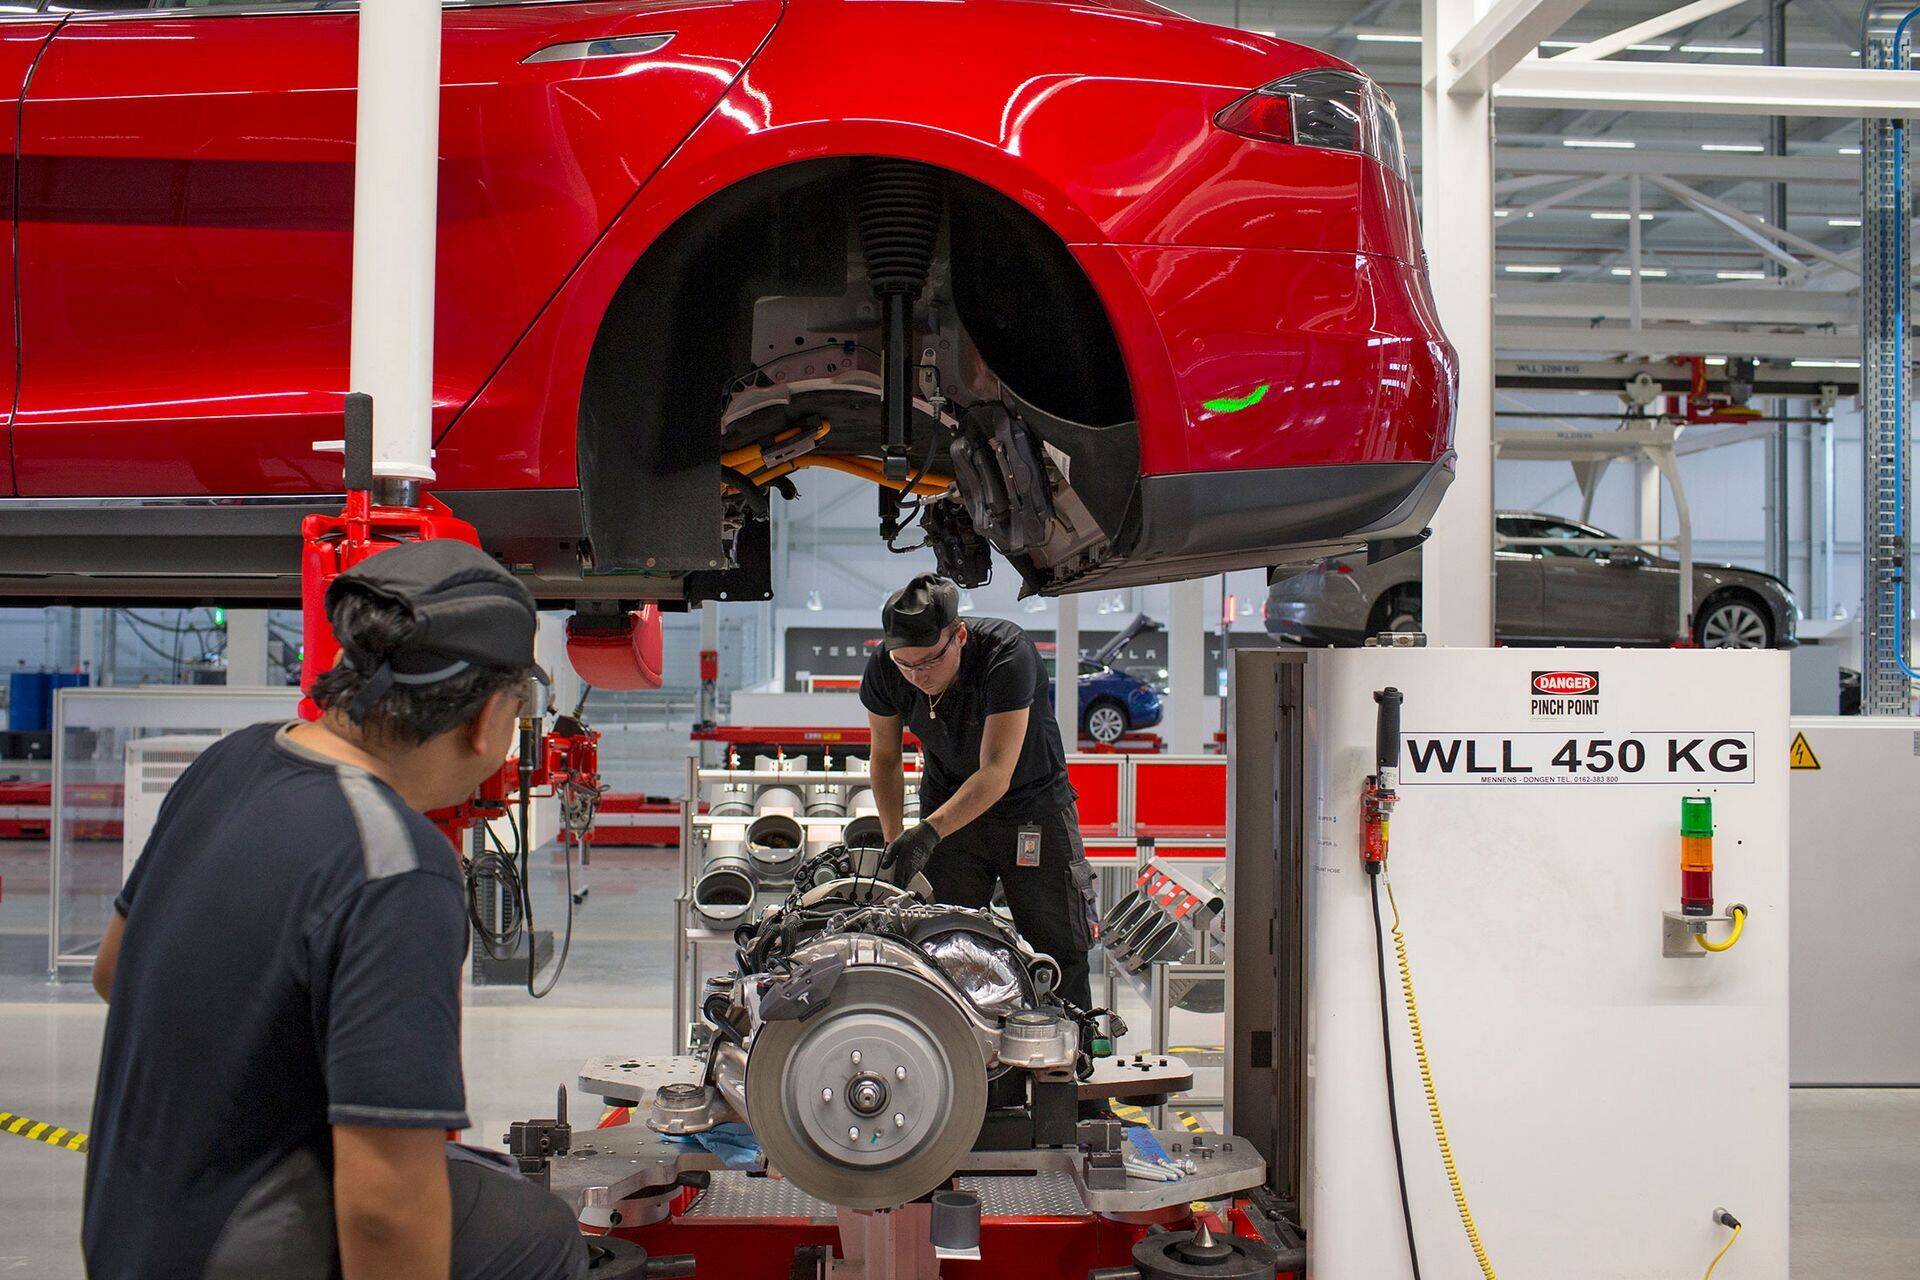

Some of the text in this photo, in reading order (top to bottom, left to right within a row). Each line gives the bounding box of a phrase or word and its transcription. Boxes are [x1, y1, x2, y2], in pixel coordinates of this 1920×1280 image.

[1540, 677, 1591, 689] DANGER
[1531, 699, 1600, 715] PINCH POINT
[1406, 738, 1748, 773] WLL 450 KG
[1480, 776, 1517, 784] MENNENS
[1523, 776, 1555, 784] DONGEN
